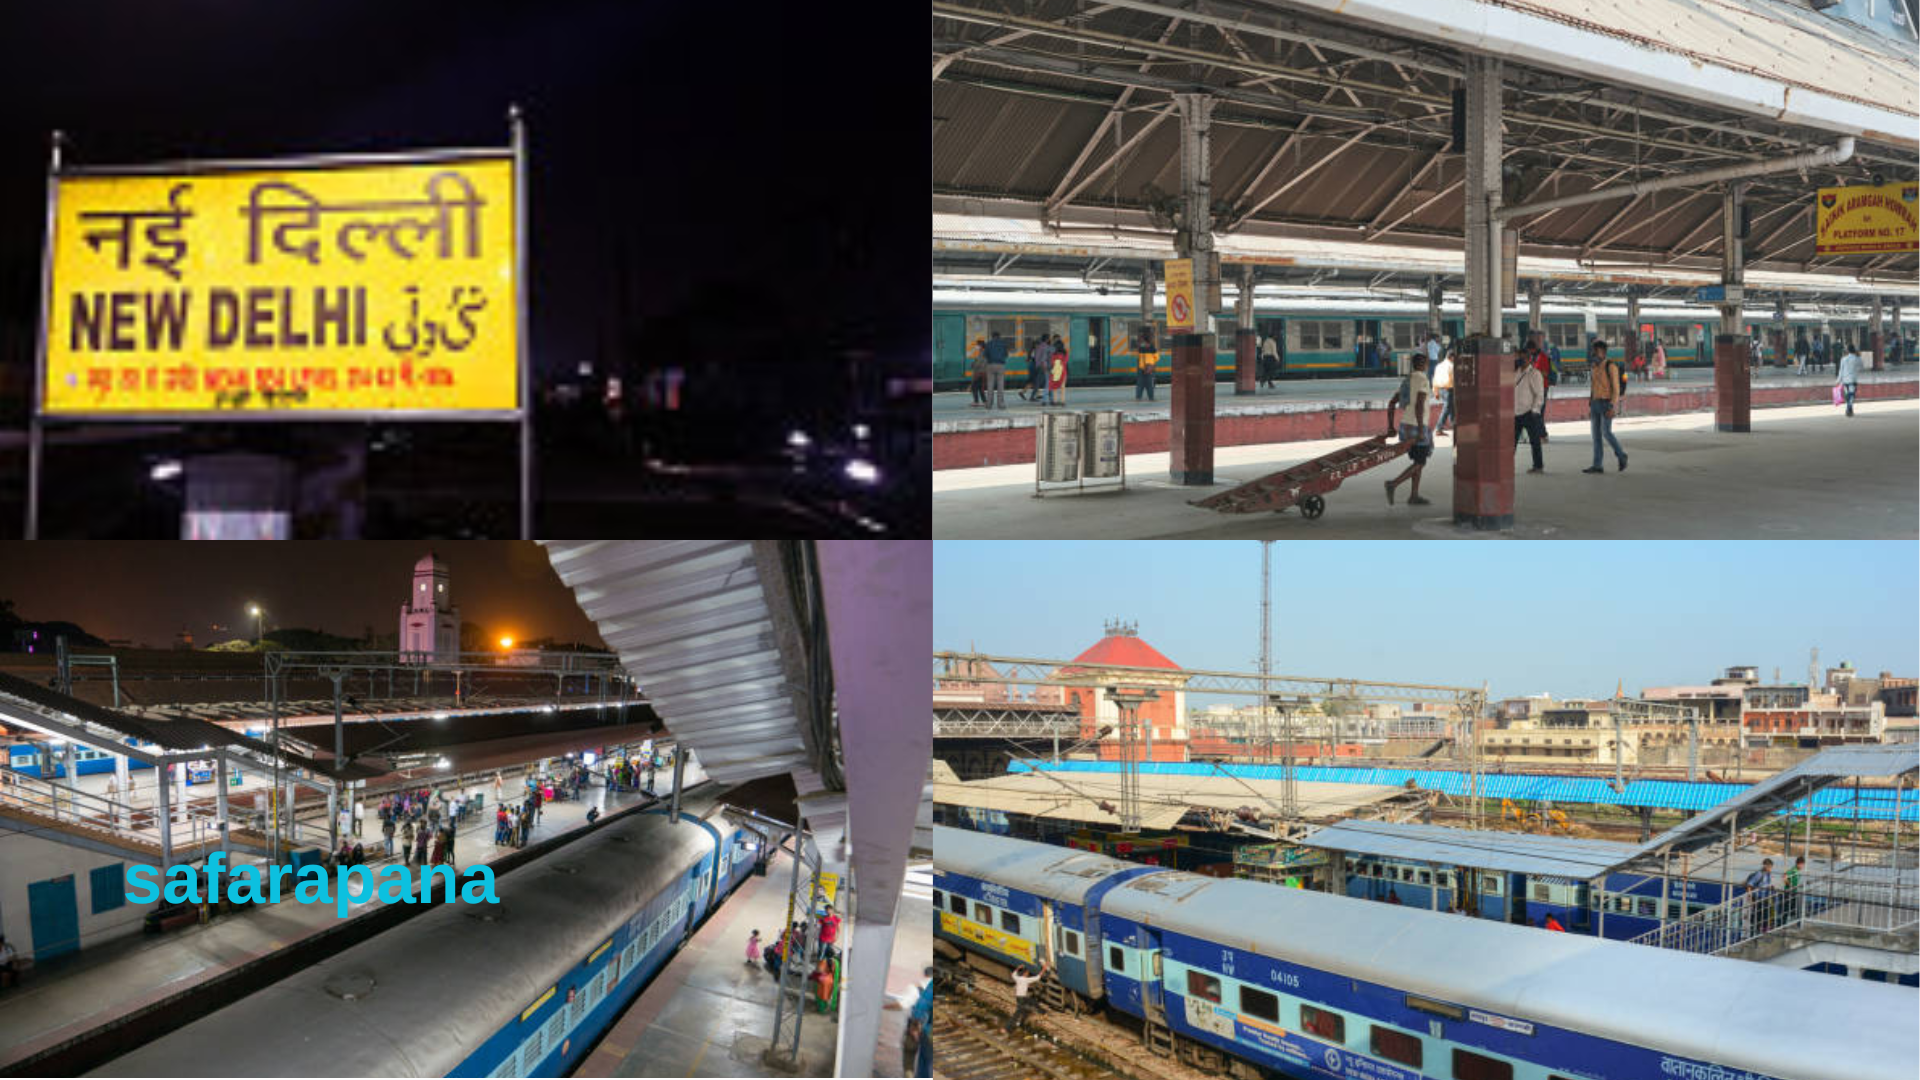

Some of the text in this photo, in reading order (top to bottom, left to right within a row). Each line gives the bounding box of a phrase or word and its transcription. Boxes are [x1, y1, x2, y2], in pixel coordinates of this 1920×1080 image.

[1847, 194, 1883, 211] ARAMGAH
[78, 173, 487, 281] नई दिल्ली
[1833, 228, 1875, 239] PLATFORM
[1878, 227, 1893, 237] NO.
[69, 286, 367, 352] NEW DELHI
[1270, 969, 1300, 988] 04105
